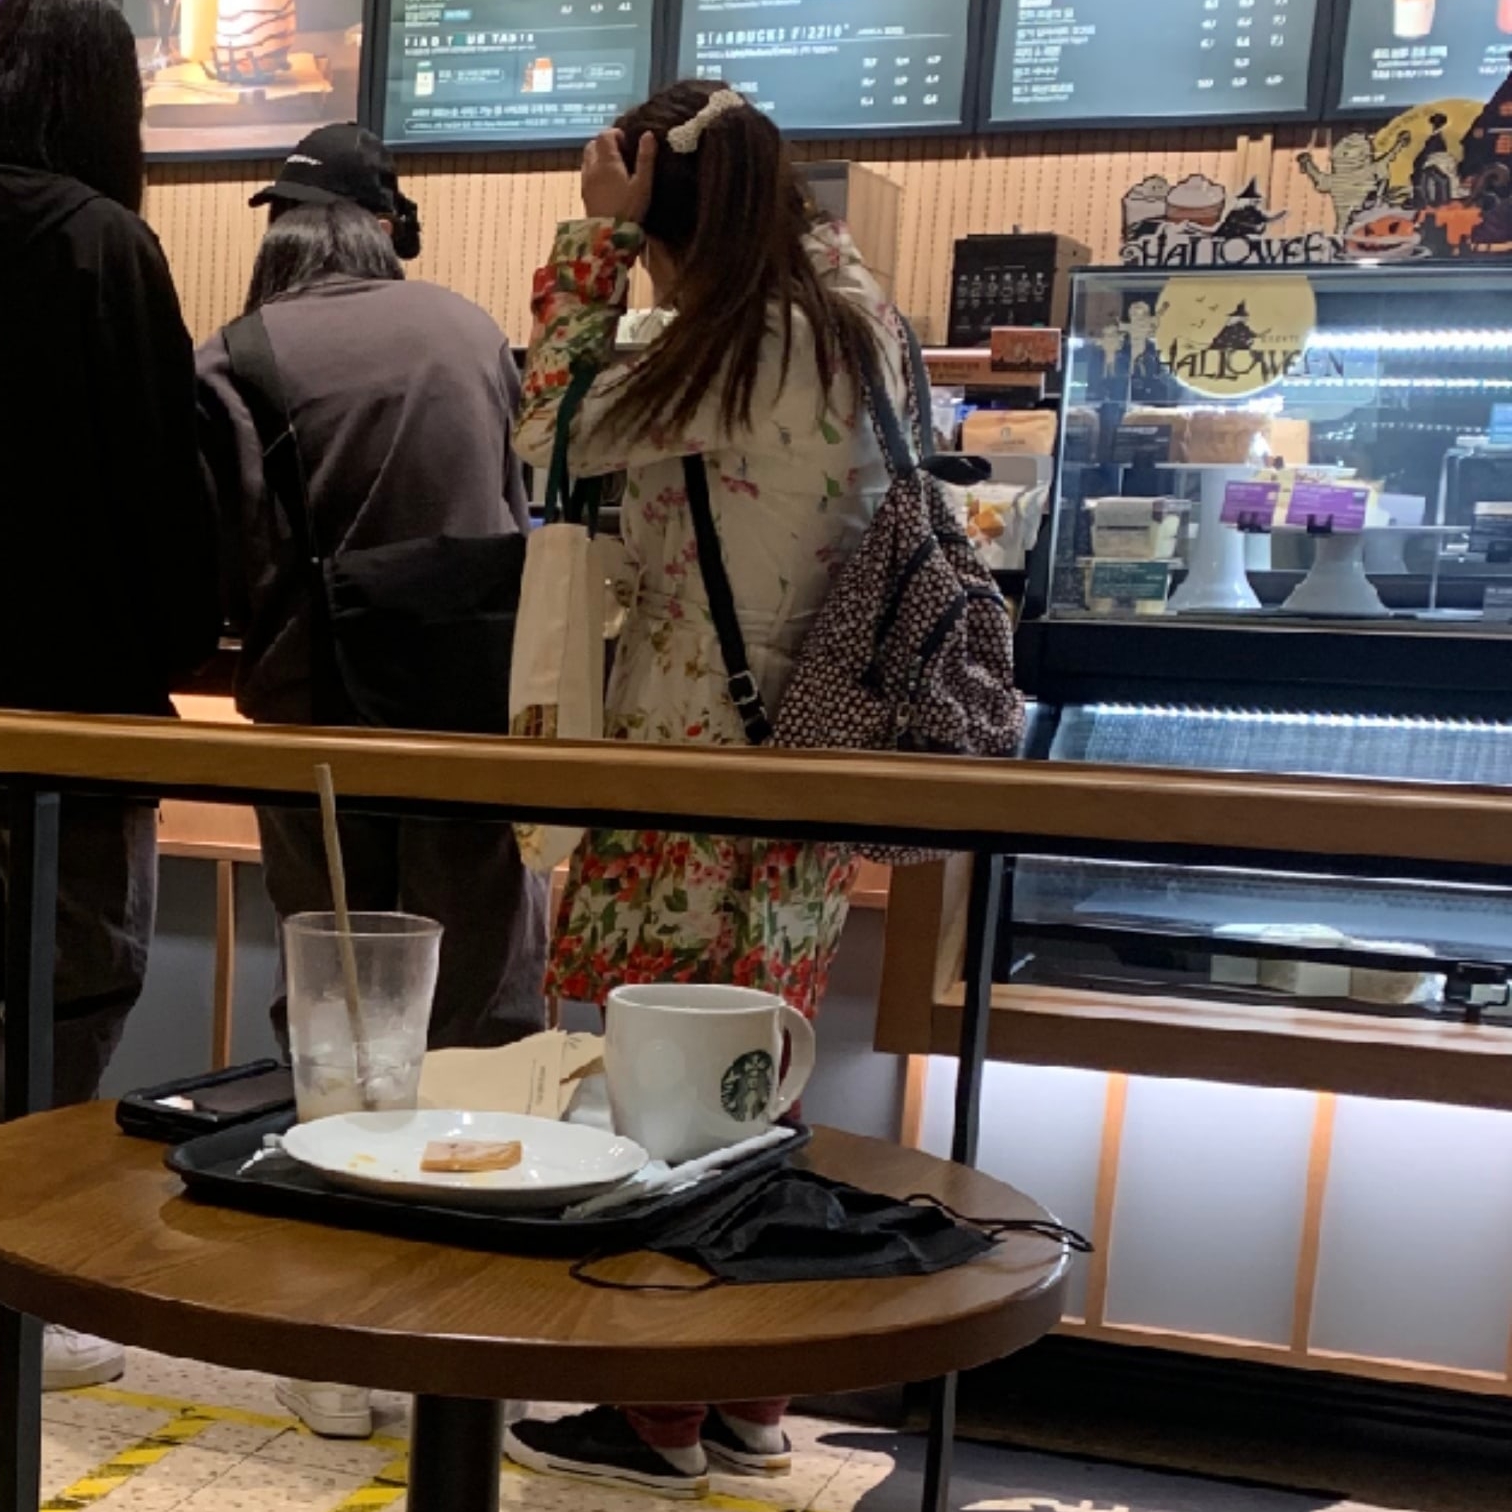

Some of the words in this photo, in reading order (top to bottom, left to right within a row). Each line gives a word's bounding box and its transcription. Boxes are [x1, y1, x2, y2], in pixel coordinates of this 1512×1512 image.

[696, 28, 785, 47] STARBUCKS
[1121, 231, 1346, 267] HALLOWEEN
[1152, 338, 1345, 383] HALLOWEEN
